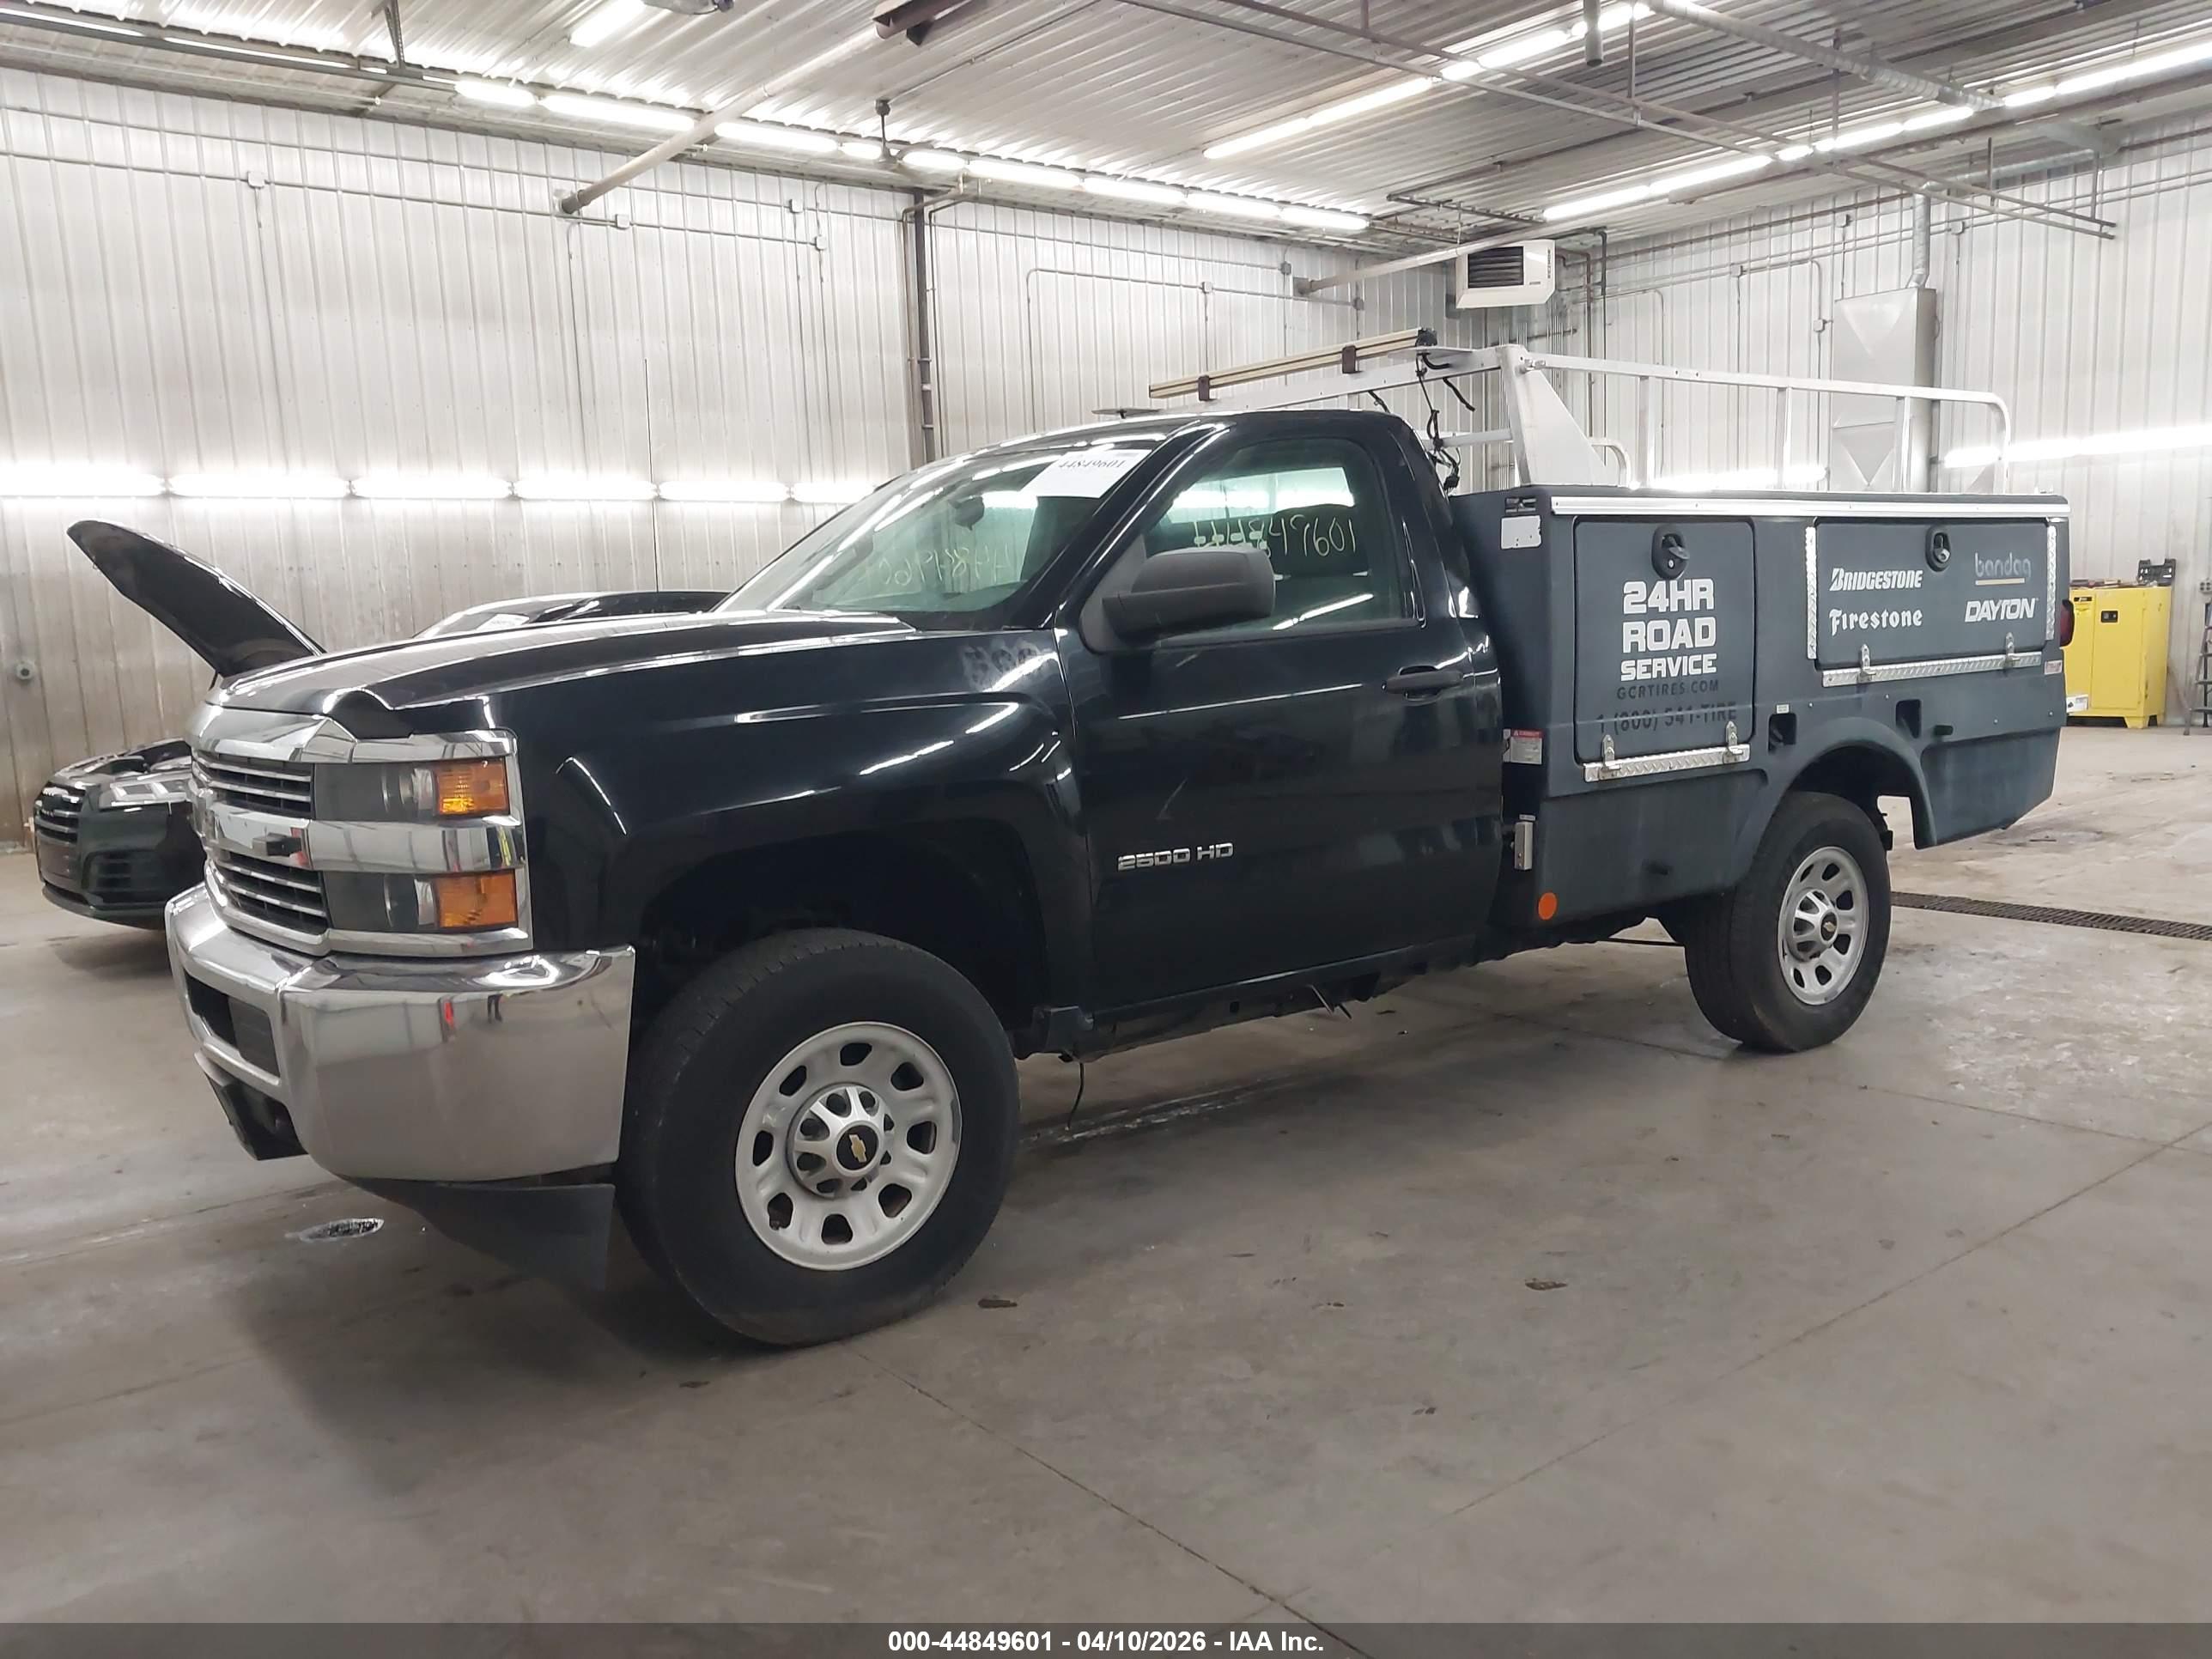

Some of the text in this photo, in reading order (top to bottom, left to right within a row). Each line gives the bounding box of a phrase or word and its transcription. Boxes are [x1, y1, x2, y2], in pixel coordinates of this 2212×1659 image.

[1829, 568, 1923, 592] BRIDGESTONE
[1975, 552, 2033, 579] bandag
[1623, 578, 1715, 615] 24HR
[1965, 598, 2036, 623] DAYTON
[1622, 617, 1717, 653] ROAD
[1829, 608, 1923, 637] Firestone
[1620, 653, 1717, 682] SERVICE
[1617, 678, 1719, 701] GCRTIRES.COM
[1613, 706, 1658, 736] (800)
[1664, 701, 1738, 727] 541-TIRE
[1118, 839, 1234, 872] 2500 HD
